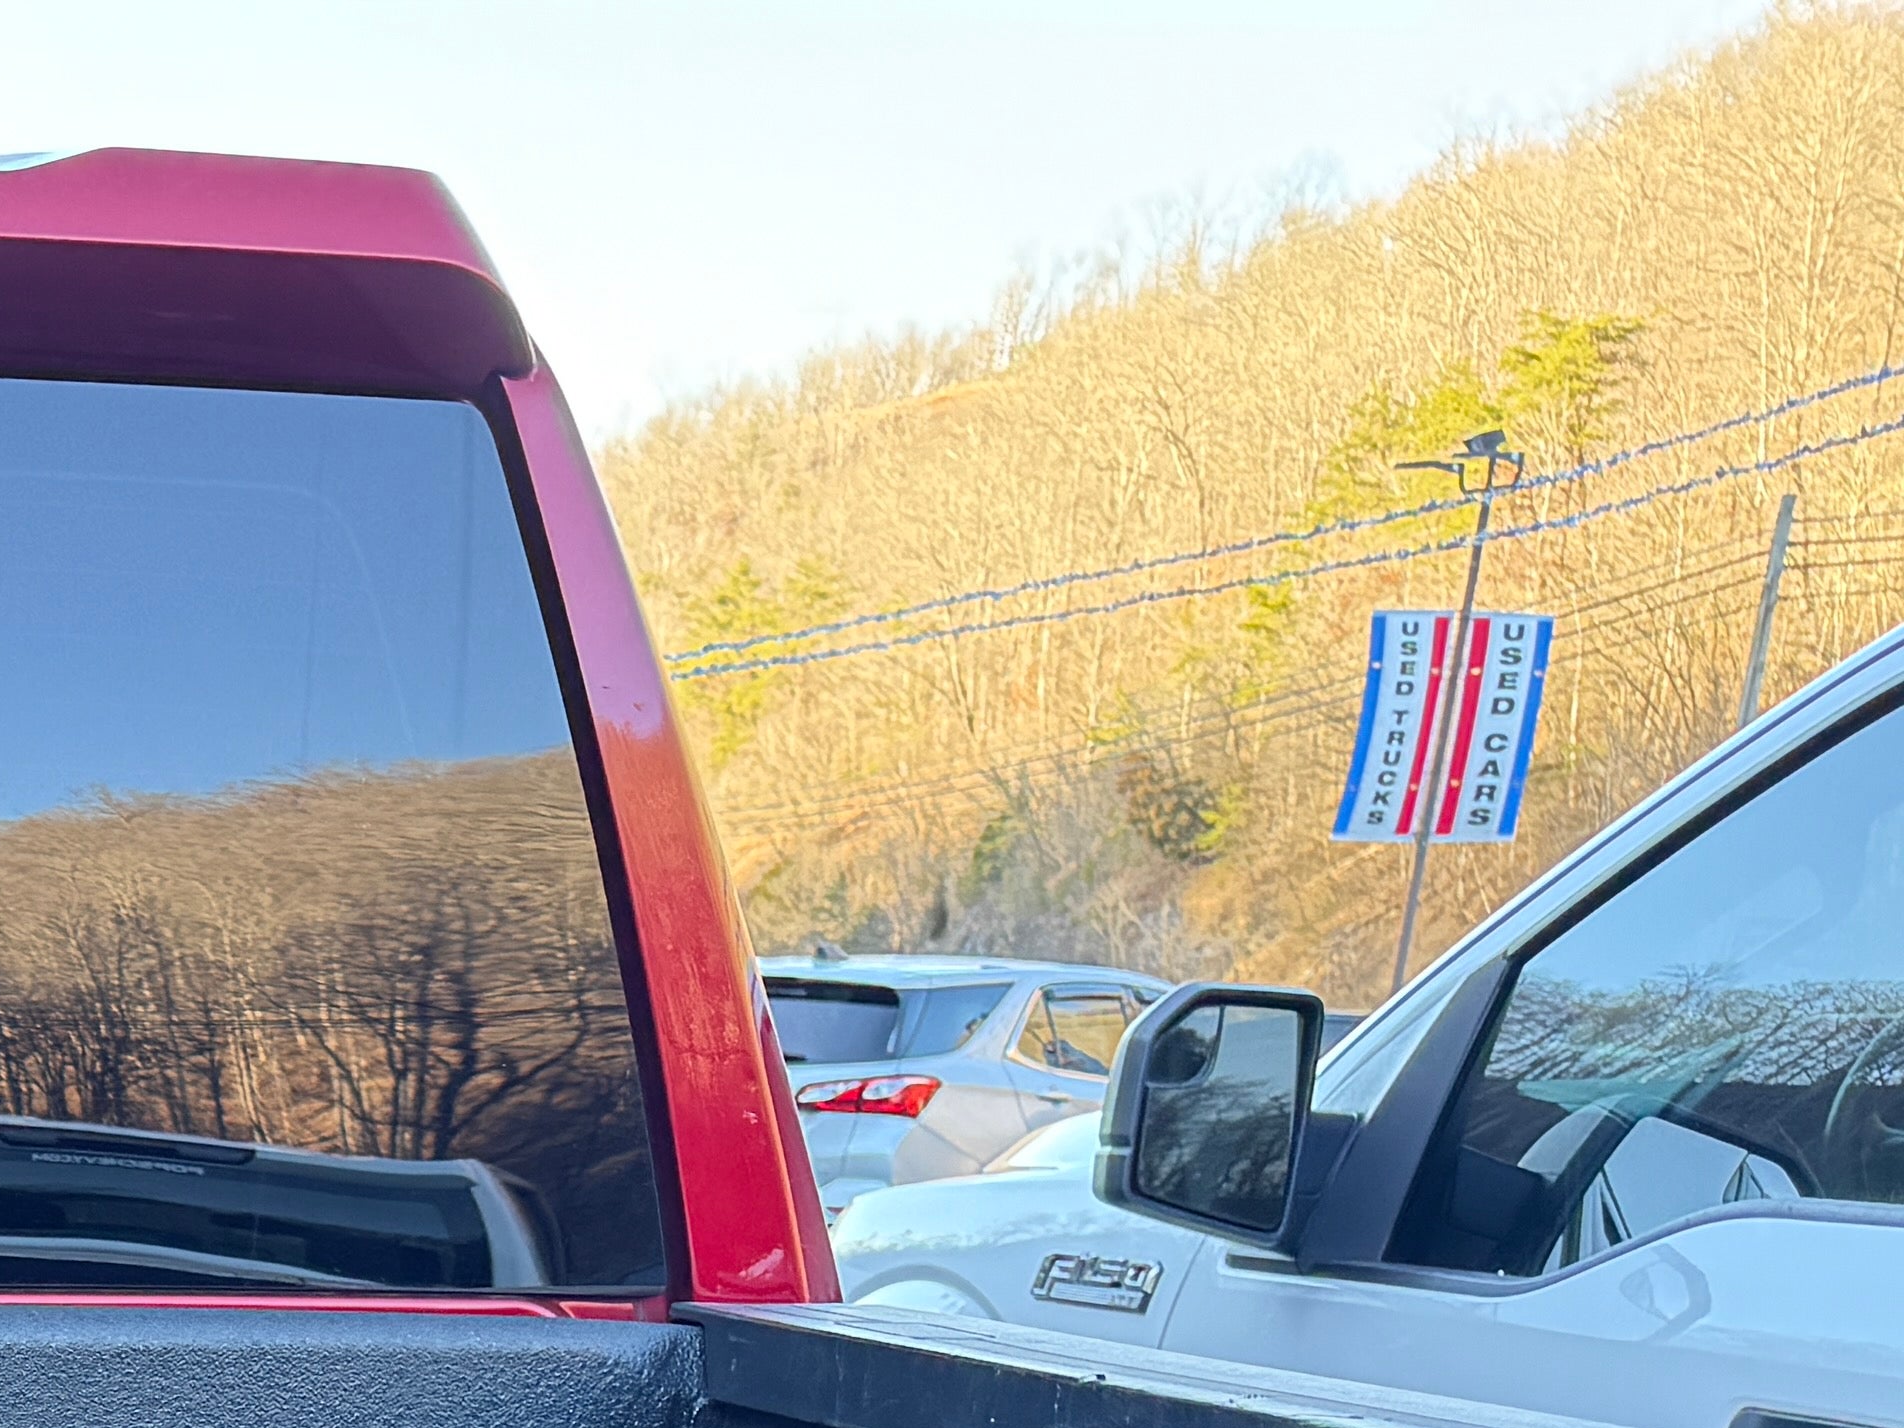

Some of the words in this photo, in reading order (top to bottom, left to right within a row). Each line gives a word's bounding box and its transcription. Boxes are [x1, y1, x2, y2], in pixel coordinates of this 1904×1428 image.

[1395, 621, 1420, 696] USED
[1490, 623, 1525, 715] USED
[1366, 709, 1409, 825] TRUCKS
[1467, 733, 1509, 826] CARS
